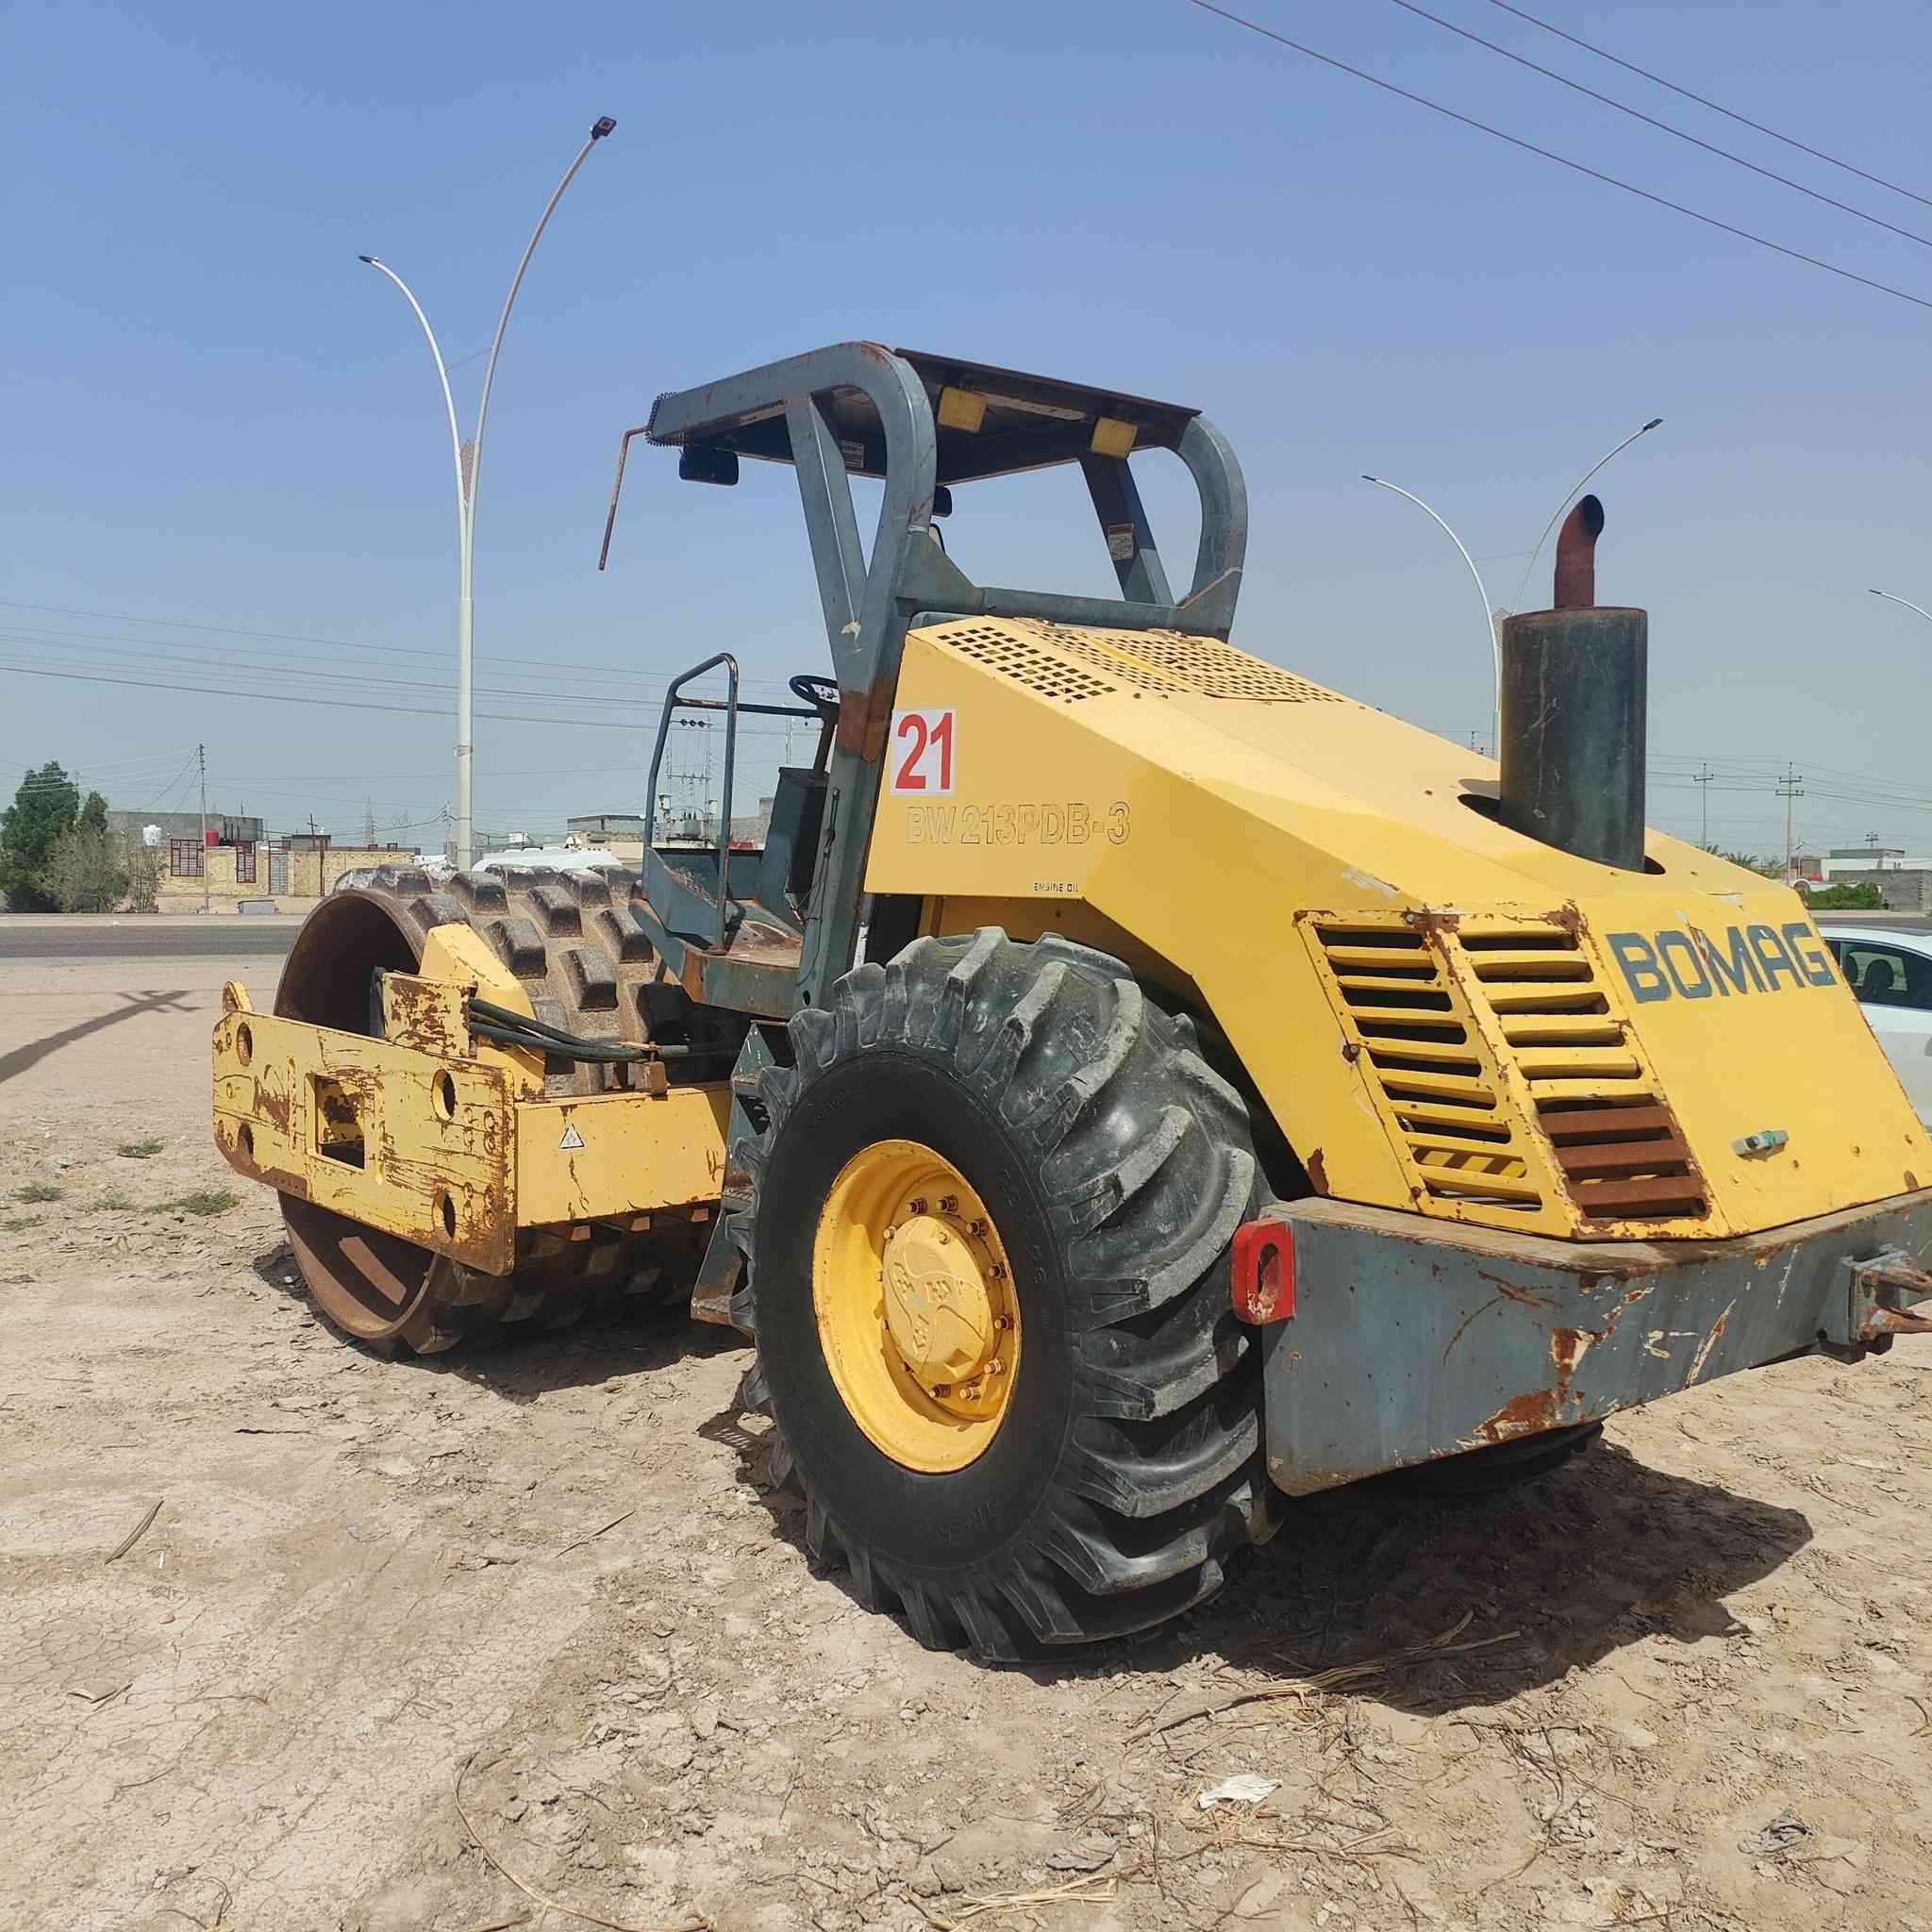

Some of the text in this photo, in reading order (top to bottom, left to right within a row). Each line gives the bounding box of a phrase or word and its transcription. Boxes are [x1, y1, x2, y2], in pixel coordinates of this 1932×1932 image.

[895, 712, 953, 790] 21
[906, 805, 957, 844] BW
[1034, 882, 1079, 892] ENGINE OIL
[1605, 922, 1838, 1004] BOMAG
